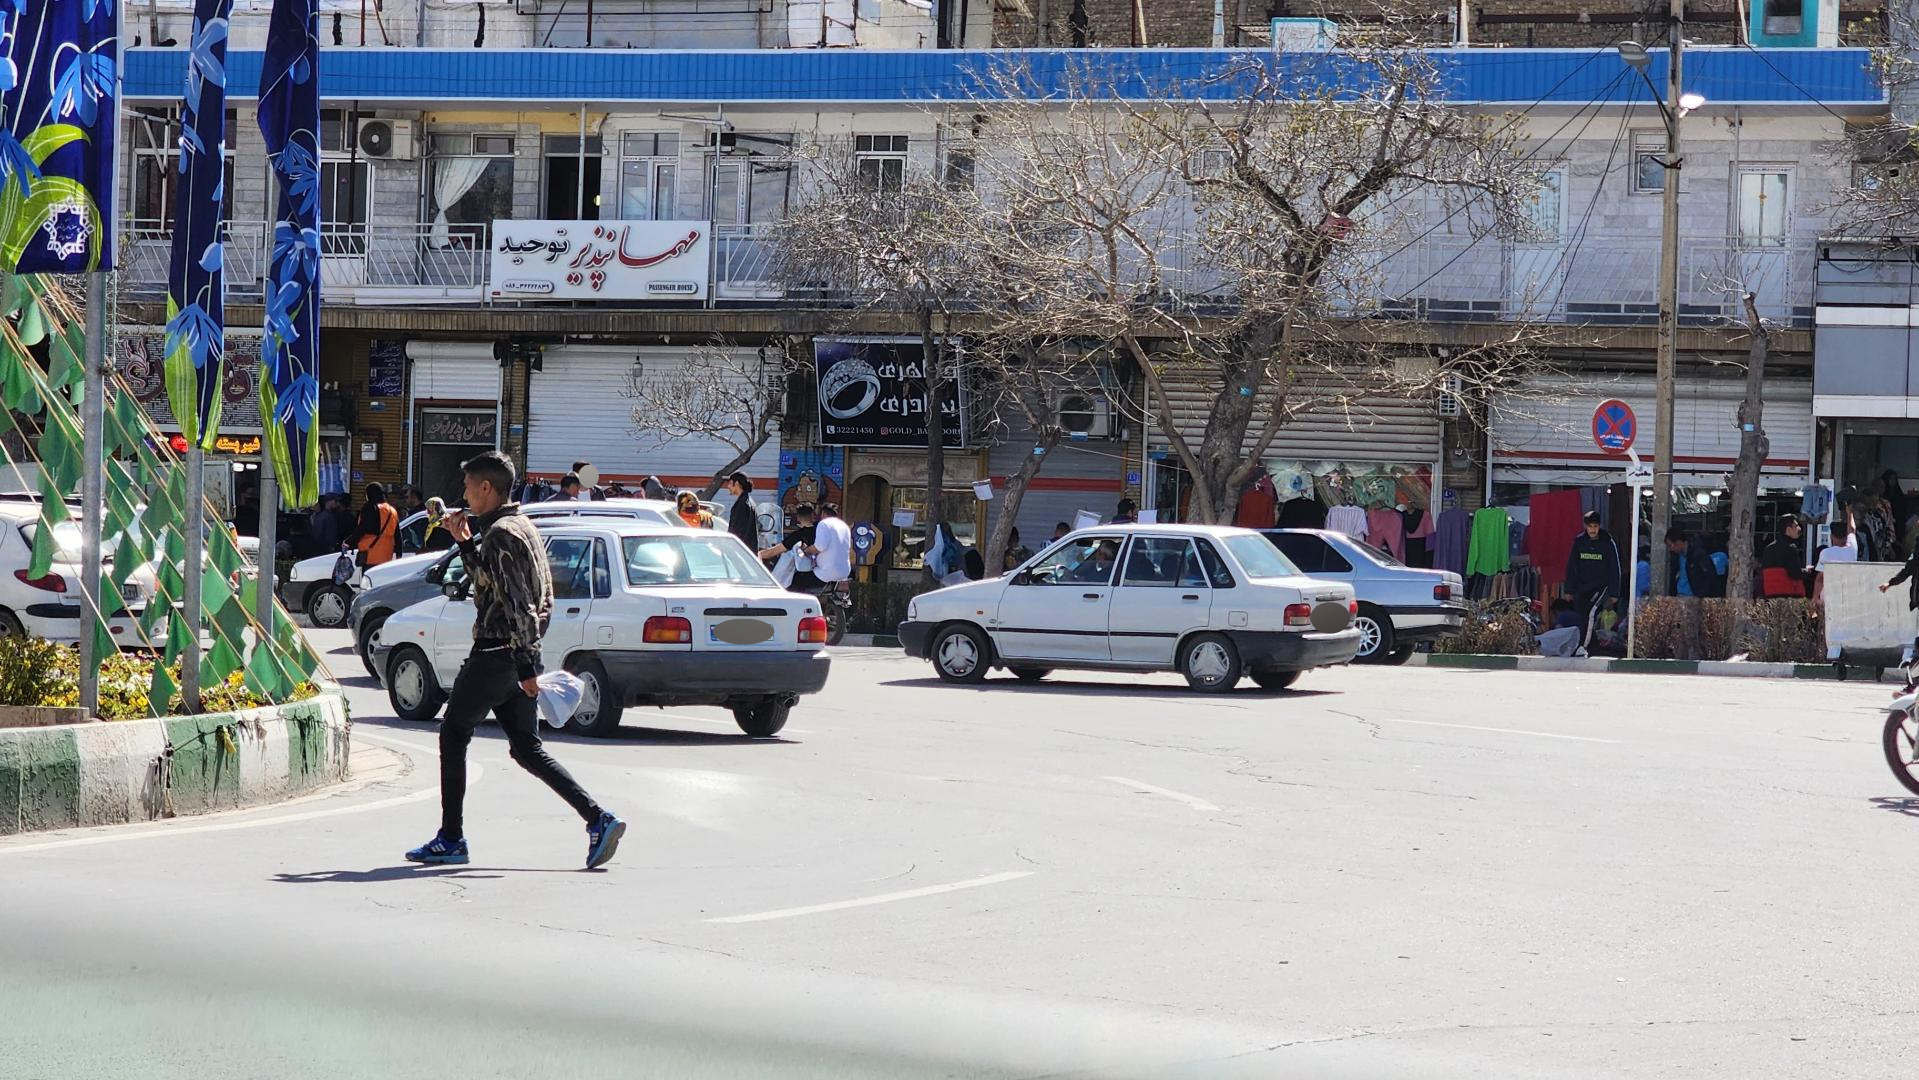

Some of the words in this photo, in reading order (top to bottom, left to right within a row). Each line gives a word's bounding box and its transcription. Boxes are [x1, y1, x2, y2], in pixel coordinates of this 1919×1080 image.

[500, 228, 570, 265] توحید
[878, 359, 957, 382] جاهری
[836, 426, 874, 434] 32221450
[216, 437, 240, 454] پسته
[240, 436, 261, 453] شیر
